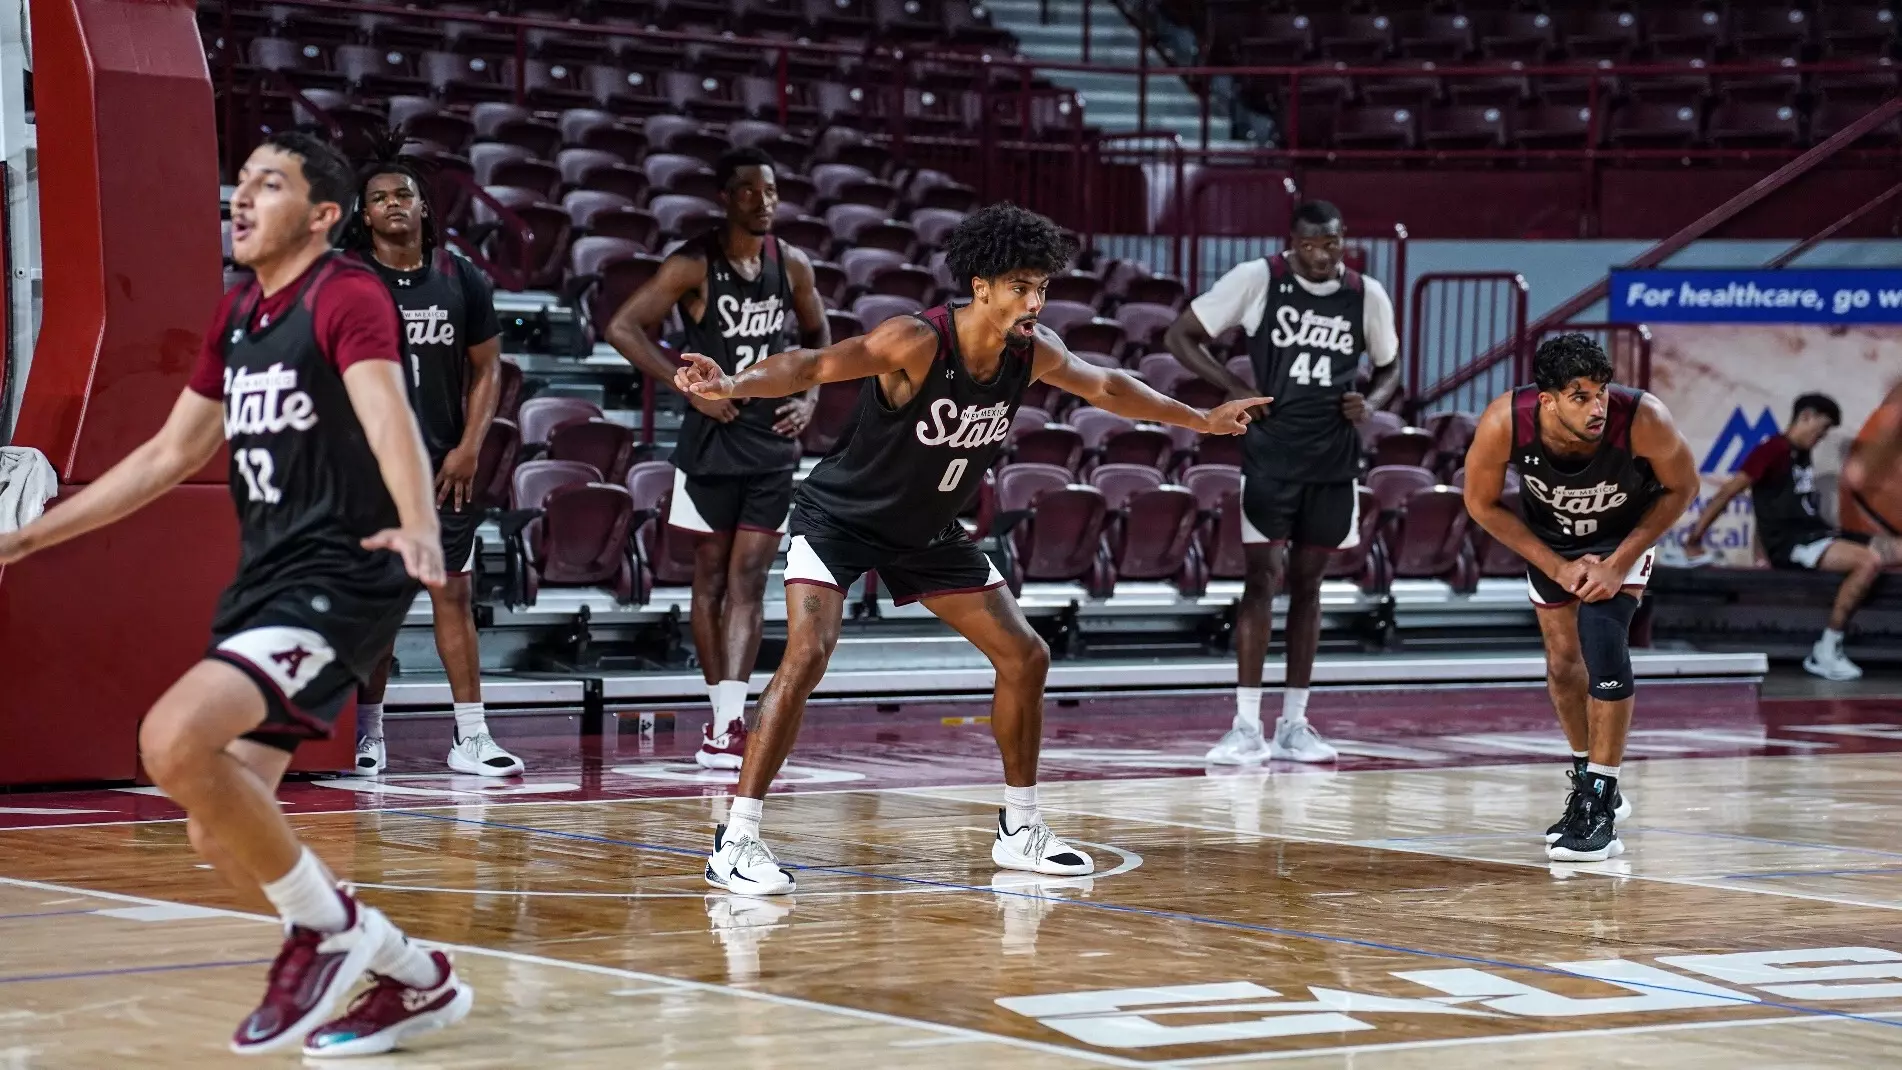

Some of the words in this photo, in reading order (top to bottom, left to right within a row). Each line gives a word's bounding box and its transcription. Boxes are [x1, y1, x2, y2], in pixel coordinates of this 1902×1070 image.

[1626, 282, 1675, 308] For
[1679, 281, 1825, 312] healthcare,
[1831, 288, 1871, 315] go
[1271, 305, 1354, 355] State
[1289, 352, 1332, 387] 44
[916, 398, 1010, 449] State
[233, 448, 282, 504] 12
[937, 458, 969, 491] 0
[1579, 486, 1616, 496] MEXICO
[1524, 474, 1628, 514] State
[269, 644, 313, 679] A
